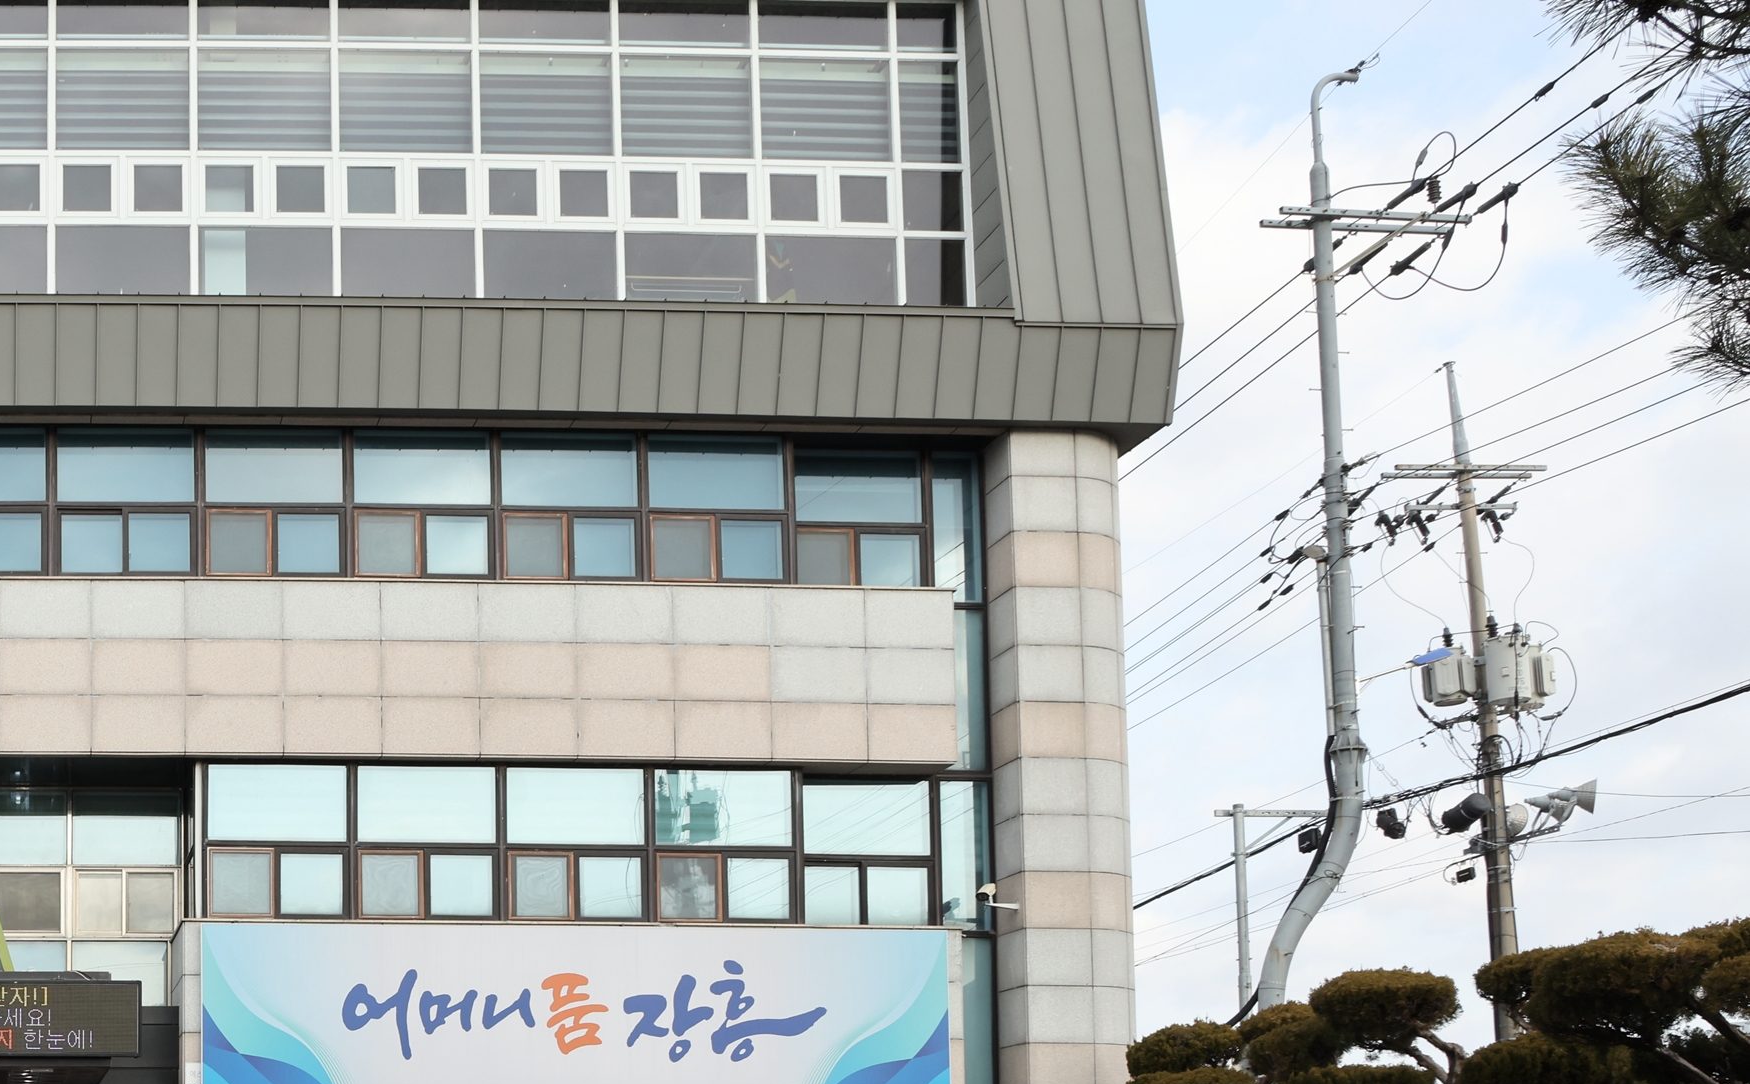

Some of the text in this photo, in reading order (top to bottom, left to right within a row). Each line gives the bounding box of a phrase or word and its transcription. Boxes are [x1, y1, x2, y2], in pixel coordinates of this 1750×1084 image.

[24, 1029, 93, 1050] 한눈에!
[342, 959, 827, 1063] 어머니품 장흥
